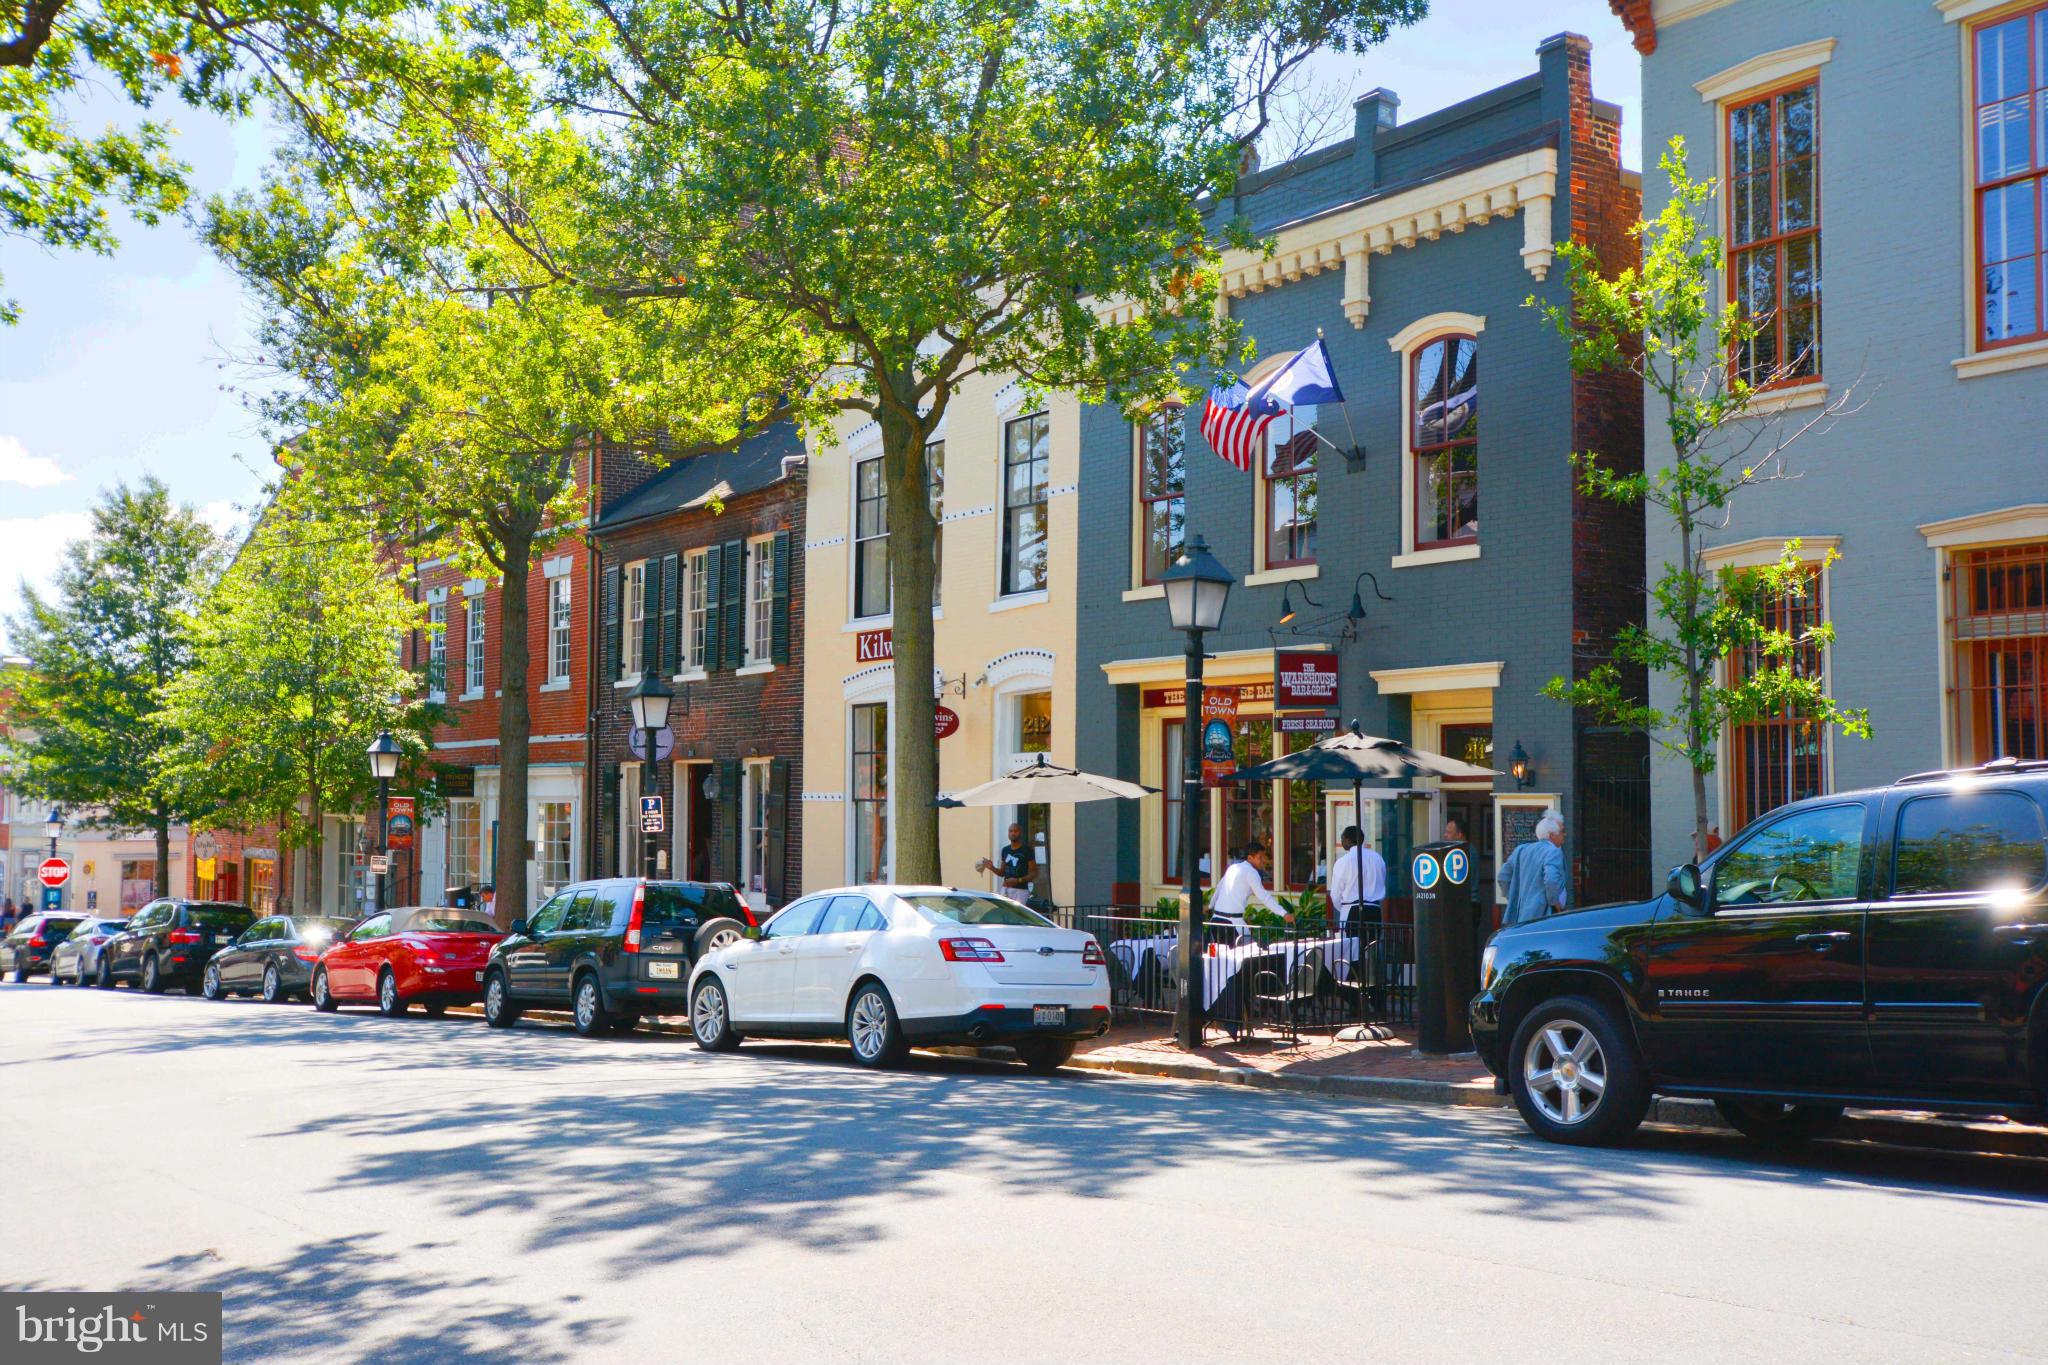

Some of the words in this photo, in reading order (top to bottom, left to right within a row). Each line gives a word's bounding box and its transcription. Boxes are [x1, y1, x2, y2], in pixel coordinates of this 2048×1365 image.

[1281, 672, 1337, 687] WAREHOUSE
[1164, 690, 1184, 704] THE
[1256, 685, 1274, 698] BA
[1209, 697, 1232, 706] OLD
[1205, 706, 1235, 715] TOWN
[1282, 720, 1304, 729] FRESH
[1305, 720, 1336, 729] SEAFOOD
[647, 799, 656, 809] P
[40, 866, 67, 877] STOP
[1420, 859, 1432, 884] P
[1453, 854, 1464, 879] P
[1667, 989, 1710, 997] TAHOE
